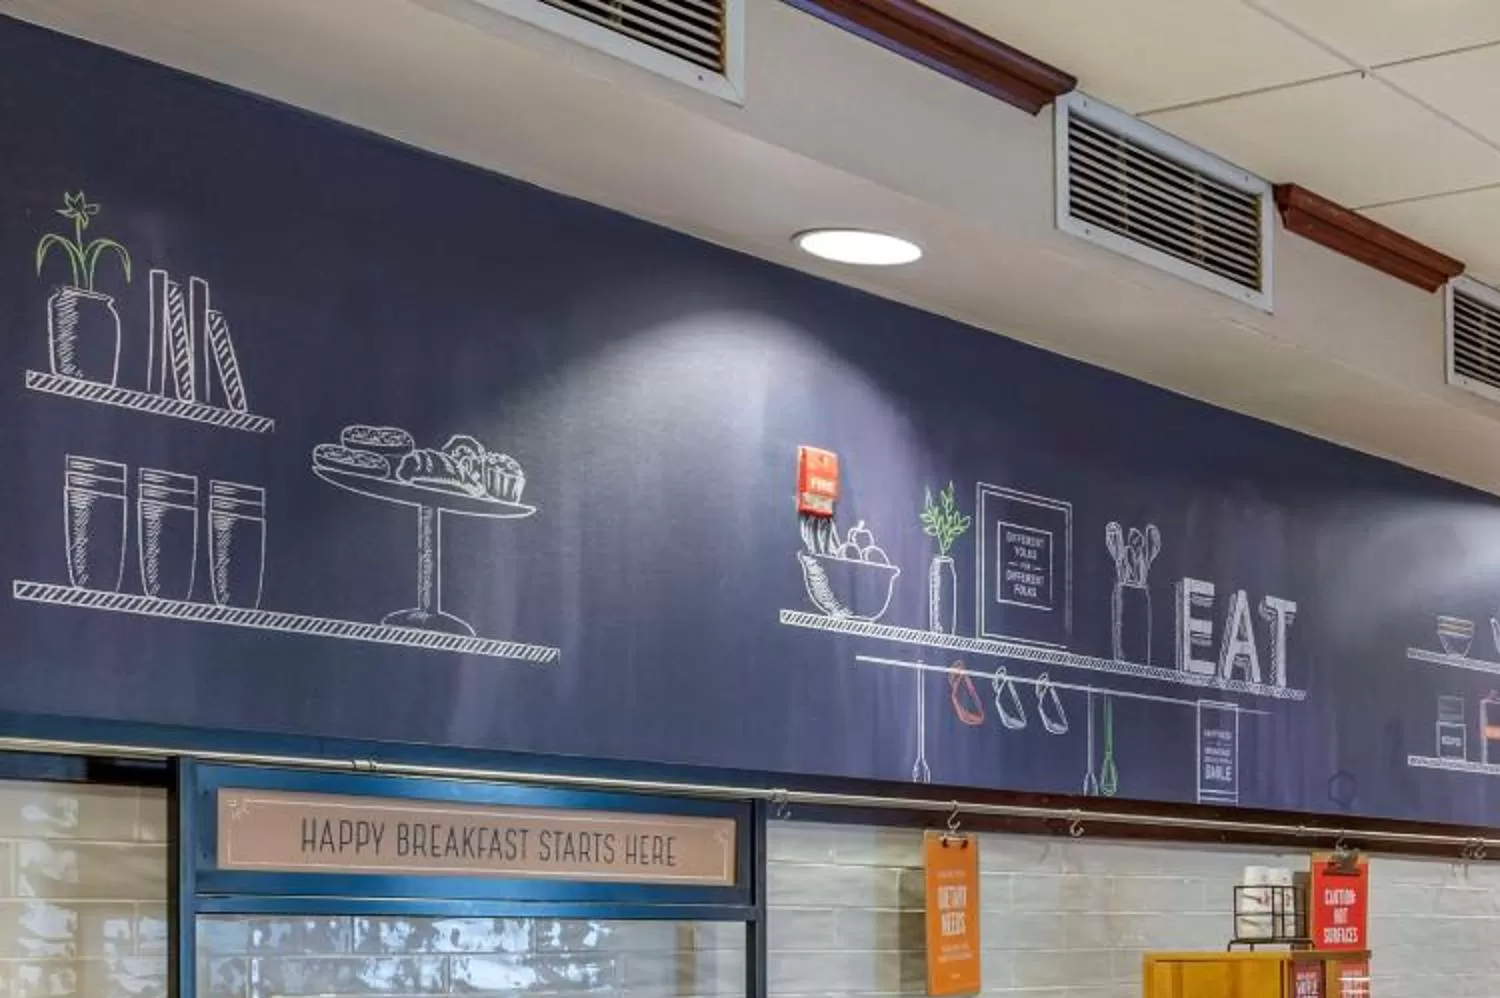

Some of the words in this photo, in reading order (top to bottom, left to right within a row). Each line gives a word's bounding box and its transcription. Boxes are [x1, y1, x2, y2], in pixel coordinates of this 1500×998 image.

[1006, 531, 1045, 549] DIFFERENT
[1006, 570, 1045, 586] DIFFERENT
[1176, 577, 1297, 688] EAT
[301, 816, 385, 855] HAPPY
[397, 823, 530, 861] BREAKFAST
[539, 830, 616, 865] STARTS
[625, 834, 677, 867] HERE
